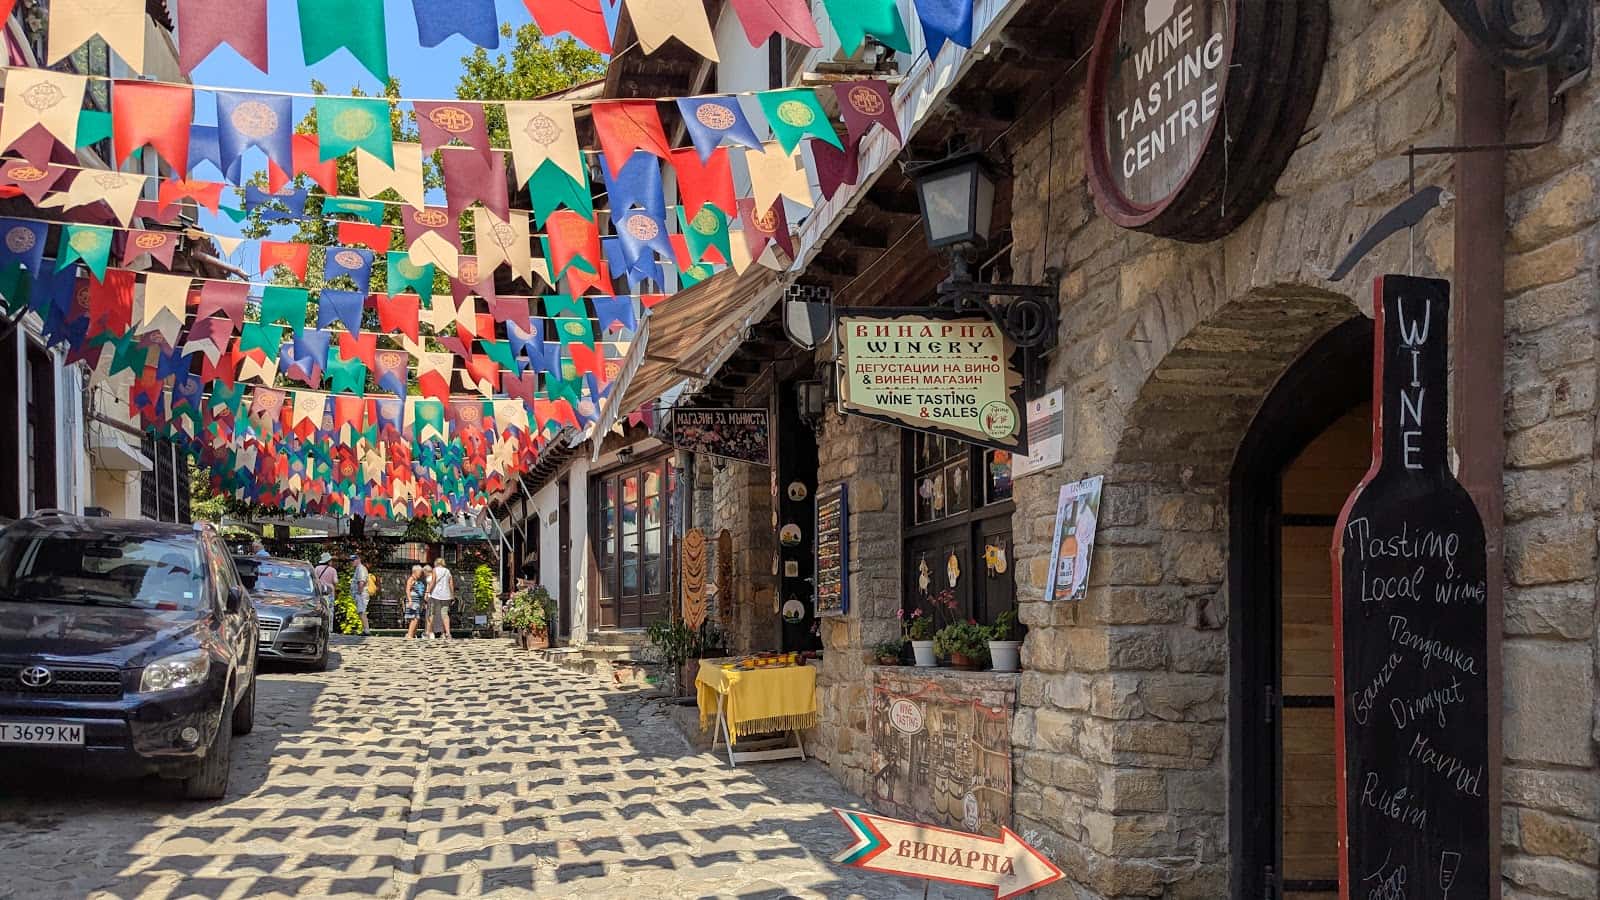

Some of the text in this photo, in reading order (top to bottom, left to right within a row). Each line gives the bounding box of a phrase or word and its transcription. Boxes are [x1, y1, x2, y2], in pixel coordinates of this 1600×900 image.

[1135, 4, 1193, 81] WINE
[1117, 32, 1223, 140] TASTING
[1123, 82, 1218, 178] CENTRE
[867, 341, 984, 353] WINERY
[856, 363, 1000, 374] ДЕГУСТАЦИИ НА ВИНО
[862, 375, 982, 385] & ВИНЕН МАГАЗИН
[1397, 296, 1430, 470] WINE
[875, 391, 976, 405] WINE TASTING
[919, 407, 978, 418] & SALES
[677, 412, 713, 424] МАГАЗИН
[715, 412, 726, 424] ЗА
[1348, 517, 1459, 579] Tasting
[1362, 566, 1425, 601] Local
[1389, 675, 1464, 729] Dimyat
